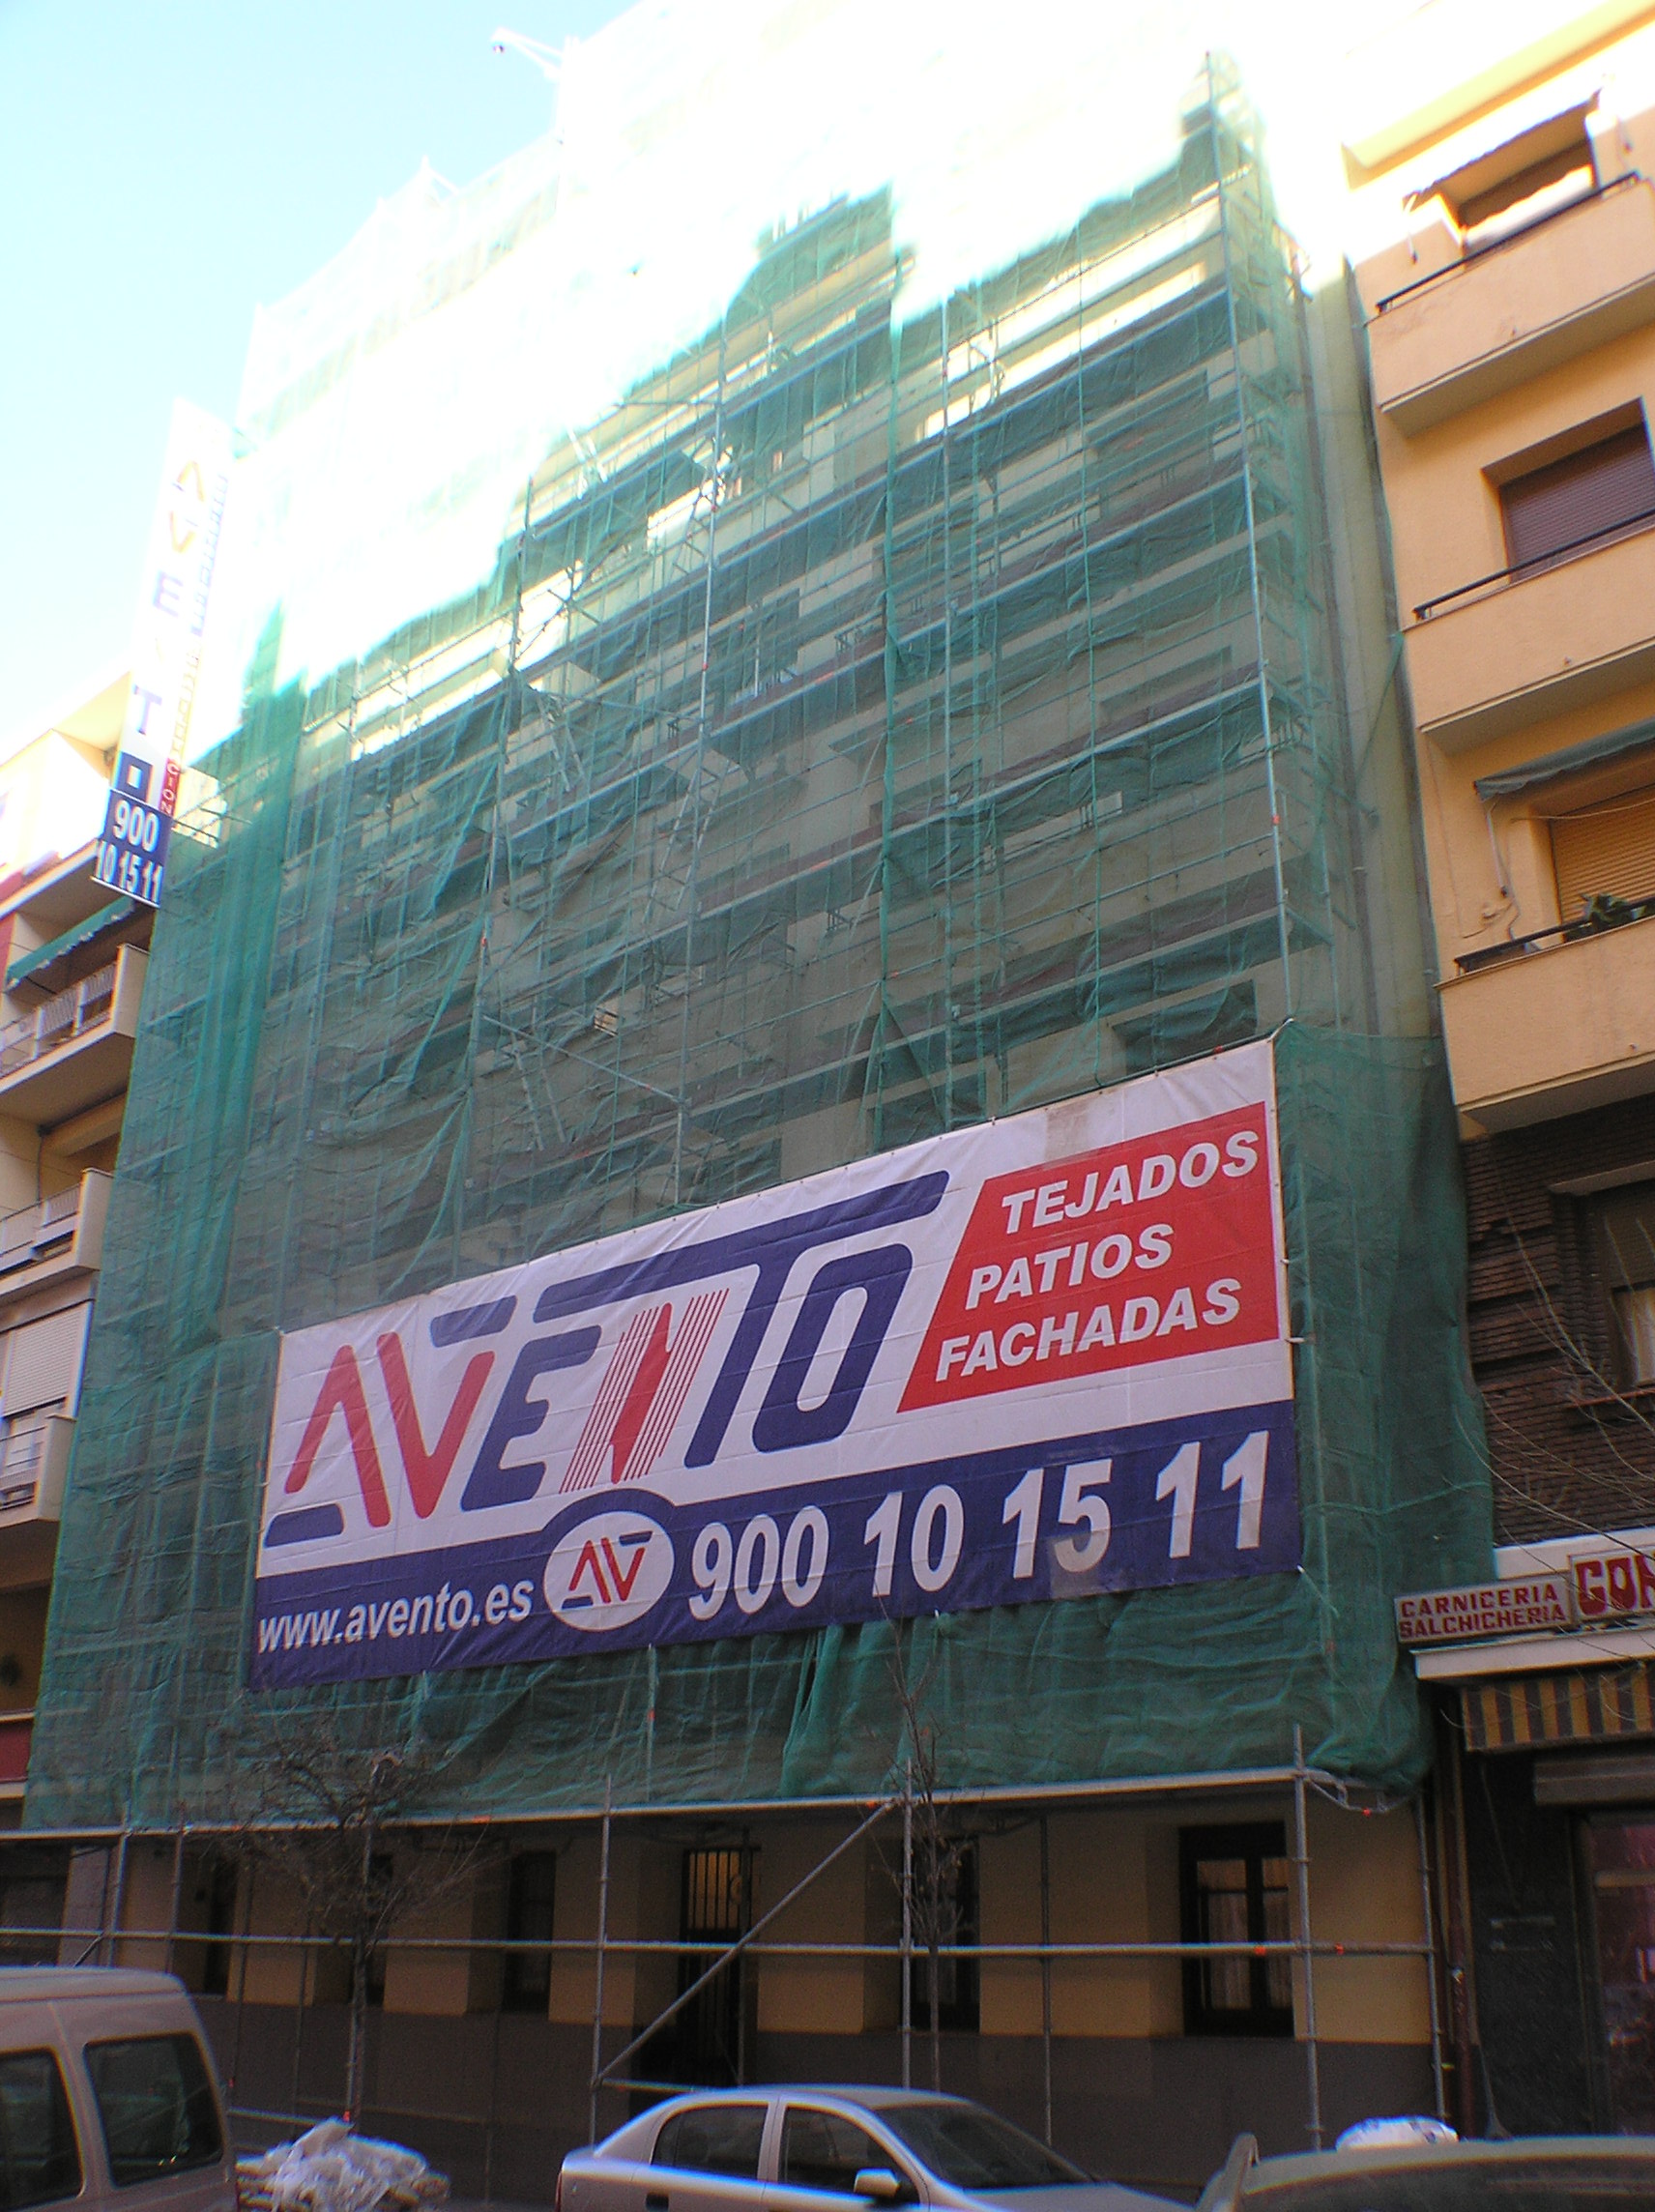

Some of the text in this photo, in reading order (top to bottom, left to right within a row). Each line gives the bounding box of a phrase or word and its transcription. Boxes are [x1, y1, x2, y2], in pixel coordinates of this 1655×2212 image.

[113, 460, 207, 803] AVETO
[112, 800, 160, 853] 900
[95, 840, 163, 903] 10 15 11
[1002, 1130, 1259, 1235] TEJADOS
[965, 1223, 1174, 1311] PATIOS
[265, 1170, 949, 1547] AVENTO
[936, 1277, 1242, 1382] FACHADAS
[690, 1430, 1269, 1621] 900 10 15 11
[258, 1579, 534, 1654] www.avento.es
[1400, 1605, 1566, 1639] SALCHICHERIA
[1402, 1584, 1557, 1618] CARNICERIA
